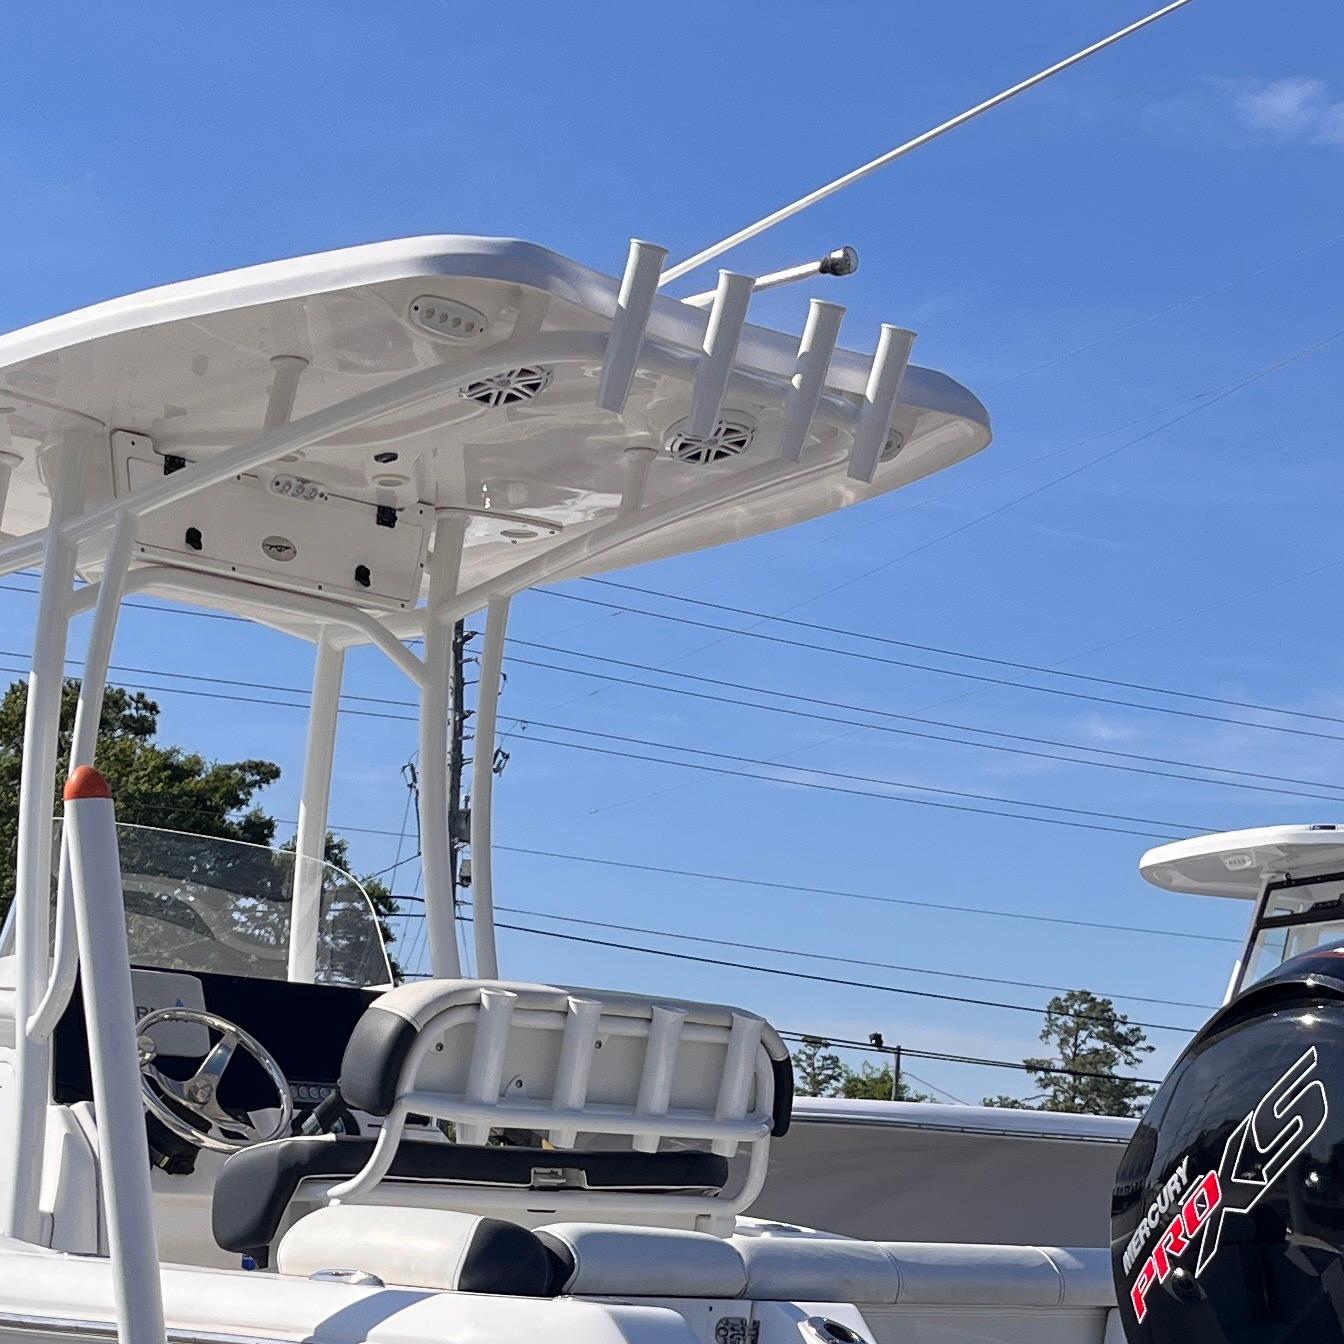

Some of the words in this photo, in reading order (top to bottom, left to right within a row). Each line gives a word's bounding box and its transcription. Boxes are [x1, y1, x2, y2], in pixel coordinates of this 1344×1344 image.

[1121, 1154, 1190, 1277] MERCURY
[1130, 1168, 1223, 1325] PRO
[1194, 1045, 1329, 1279] XS
